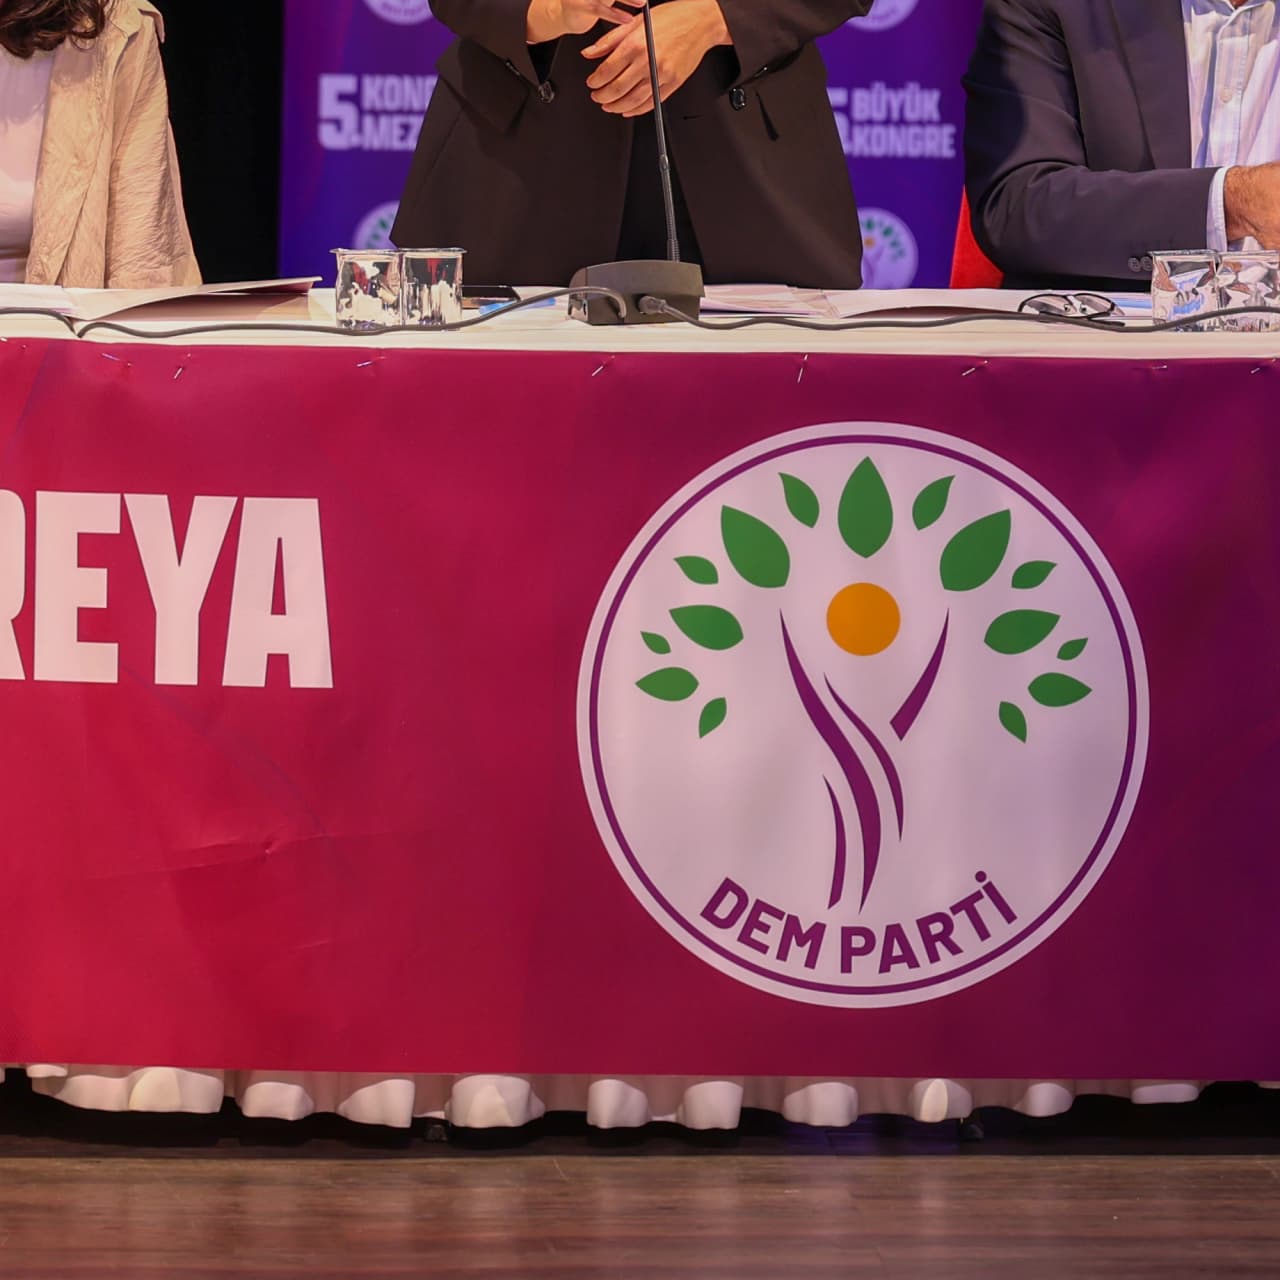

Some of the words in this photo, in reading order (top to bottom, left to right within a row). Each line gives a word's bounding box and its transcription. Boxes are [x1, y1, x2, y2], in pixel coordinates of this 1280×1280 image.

[851, 82, 940, 122] BÜYÜK
[361, 114, 424, 151] MEZ
[851, 124, 956, 158] KONGRE
[699, 876, 827, 970] DEM
[840, 870, 1019, 974] PARTİ
